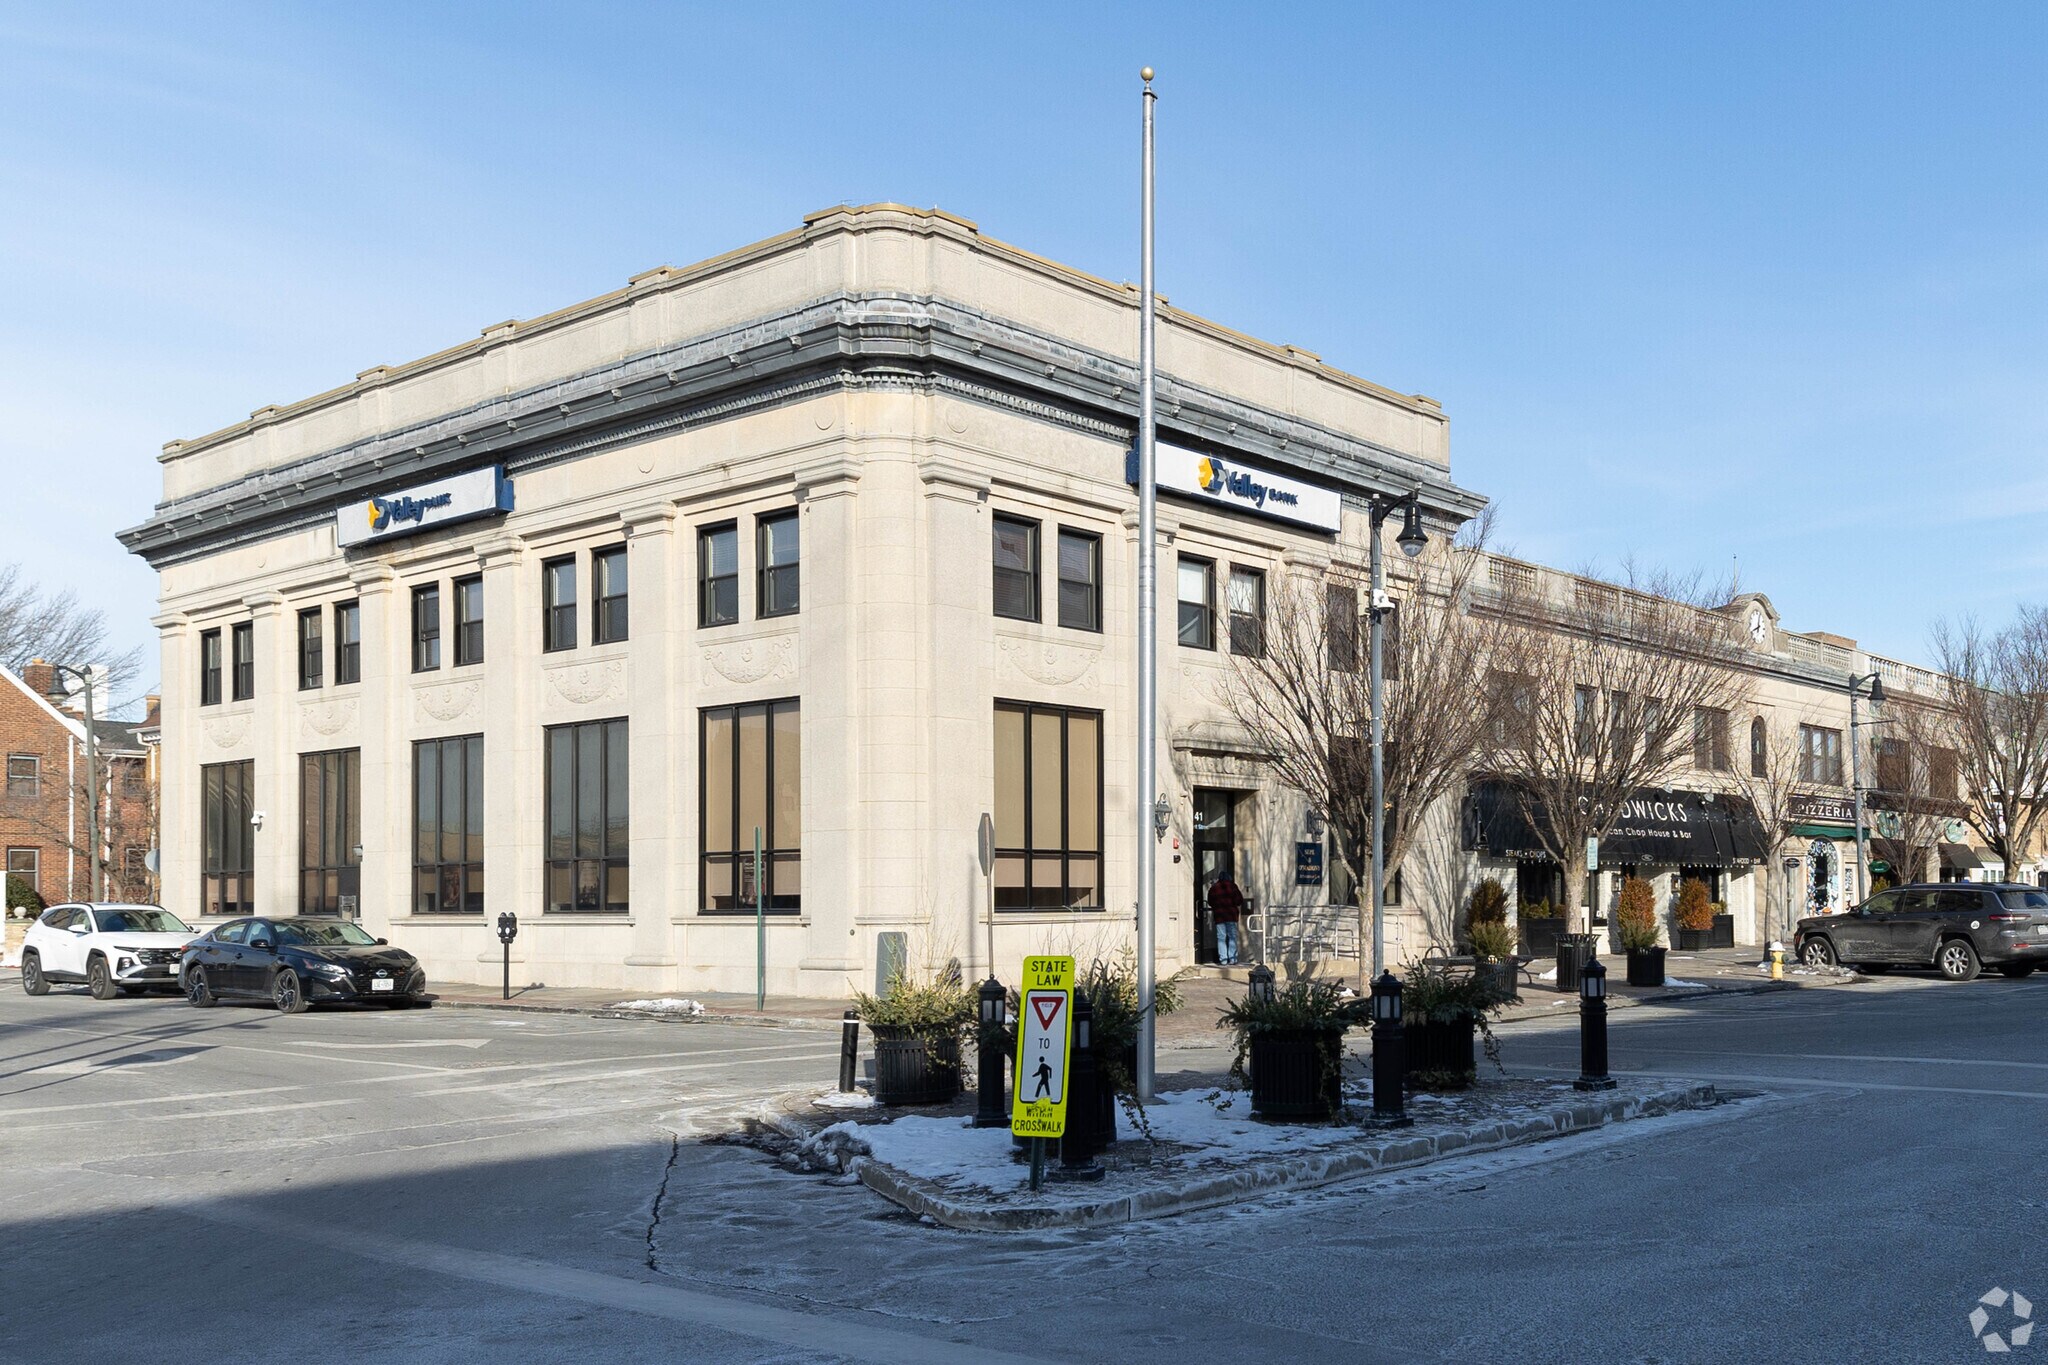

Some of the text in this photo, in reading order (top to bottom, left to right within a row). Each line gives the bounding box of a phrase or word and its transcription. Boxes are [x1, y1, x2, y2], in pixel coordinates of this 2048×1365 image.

[1226, 472, 1268, 508] Valley
[388, 496, 425, 525] Valley
[1194, 811, 1203, 821] 41
[1625, 827, 1646, 837] Chop
[1647, 829, 1671, 837] House
[1680, 830, 1692, 839] Bar
[1031, 960, 1068, 973] STATE
[1037, 974, 1062, 986] LAW
[1038, 1037, 1050, 1050] TO
[1014, 1119, 1062, 1133] CROSSWALK
